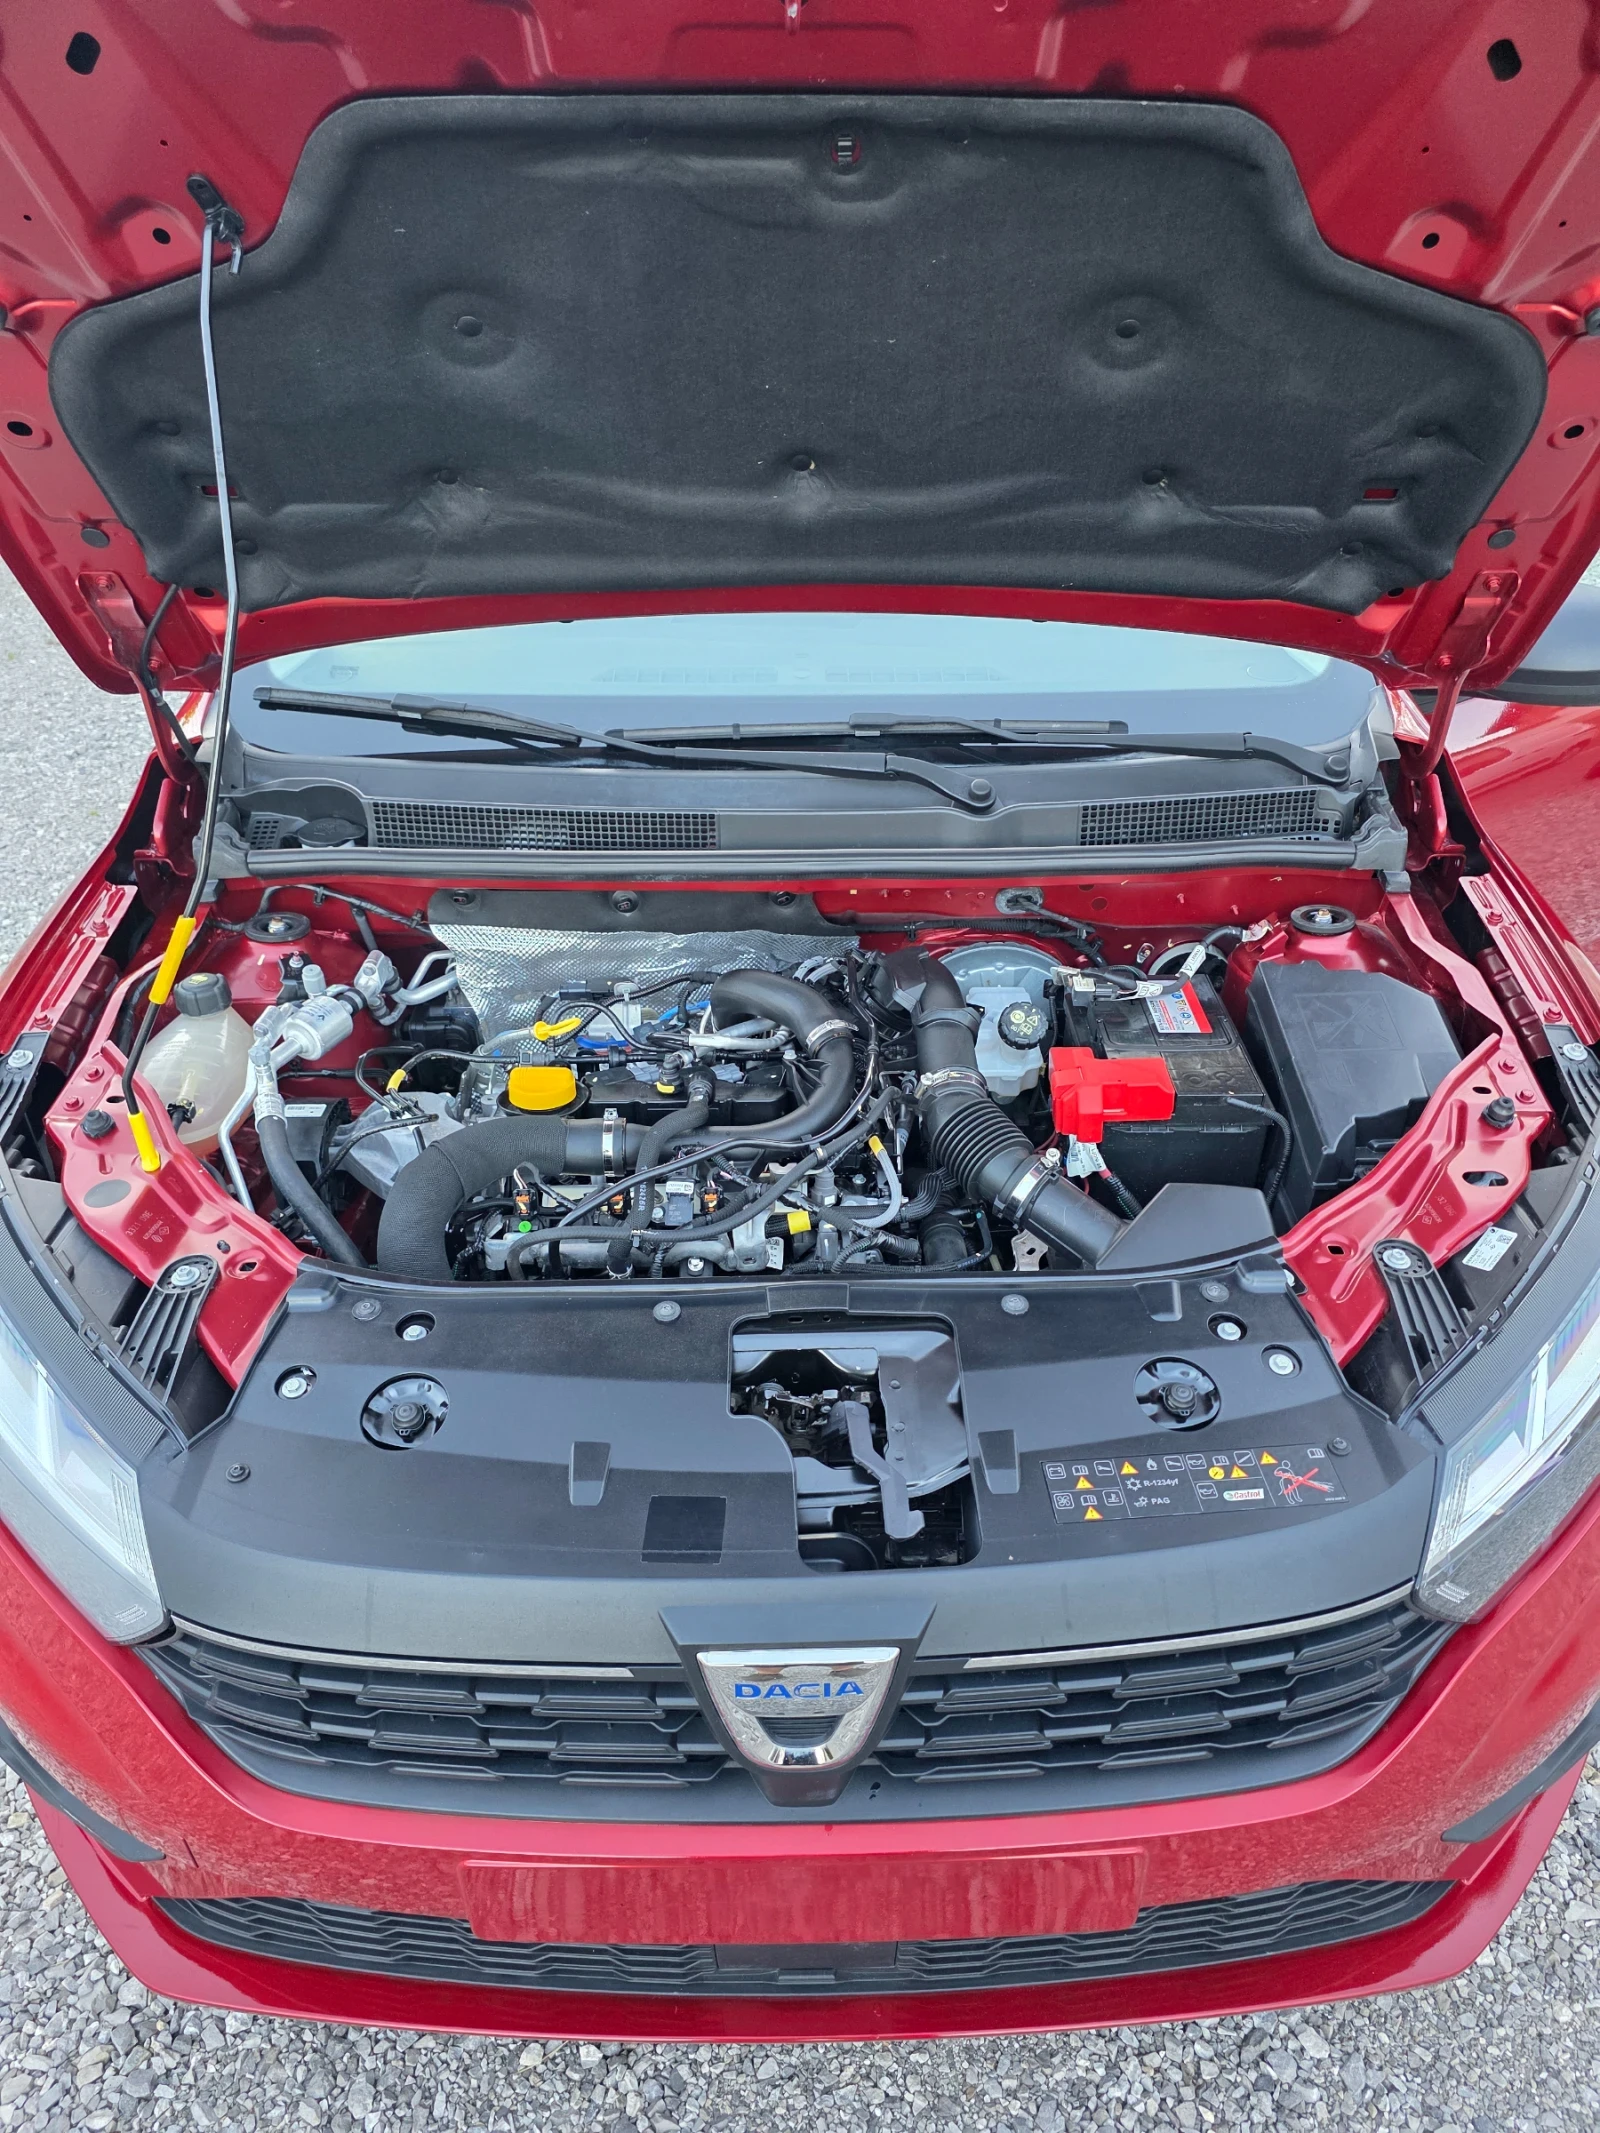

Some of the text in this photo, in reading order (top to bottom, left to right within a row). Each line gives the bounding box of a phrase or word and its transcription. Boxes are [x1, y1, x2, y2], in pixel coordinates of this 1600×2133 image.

[1233, 1490, 1261, 1500] Castrol
[1150, 1496, 1171, 1505] PAG
[734, 1681, 864, 1699] DACIA
